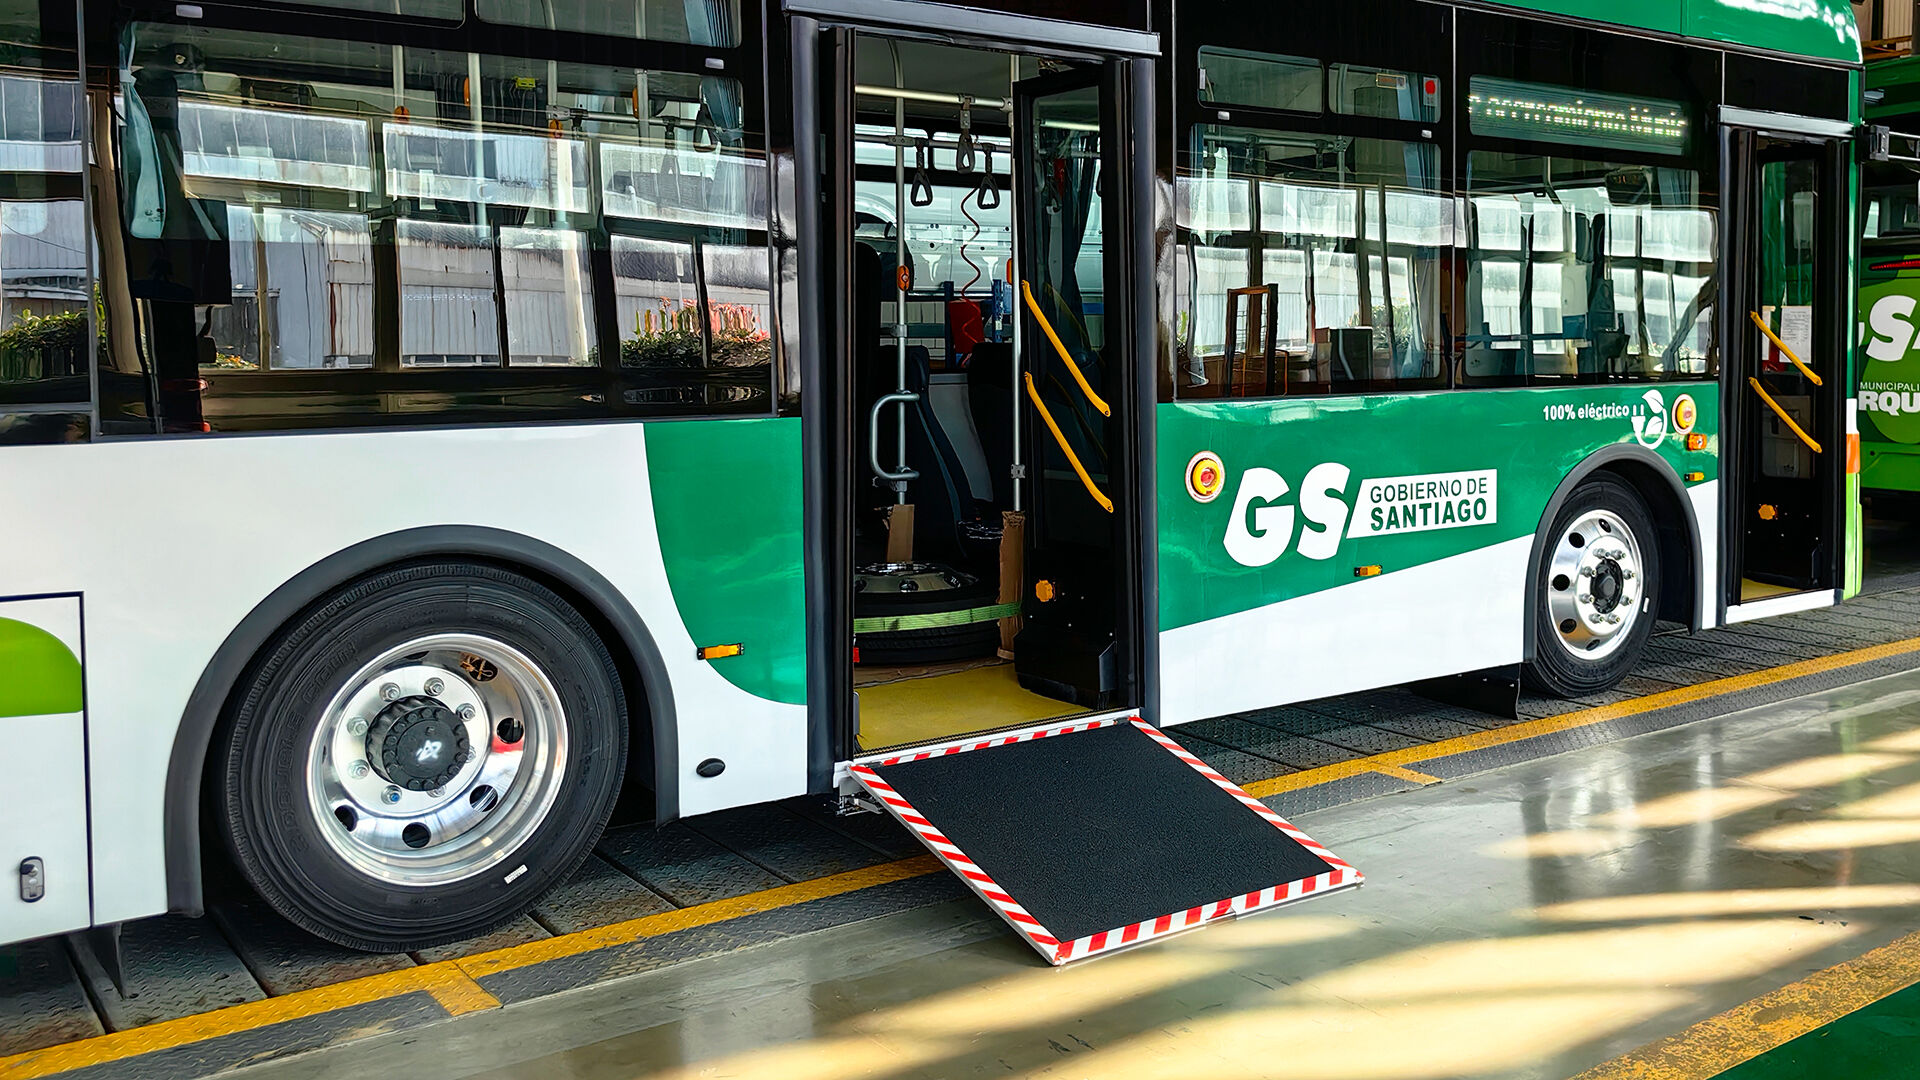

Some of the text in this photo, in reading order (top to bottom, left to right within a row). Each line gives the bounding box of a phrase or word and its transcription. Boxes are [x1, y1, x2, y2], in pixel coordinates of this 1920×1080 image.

[1543, 402, 1630, 421] 100% eléctrico
[1370, 477, 1488, 503] GOBIERNO DE
[1223, 462, 1351, 567] GS
[1370, 497, 1487, 532] SANTIAGO
